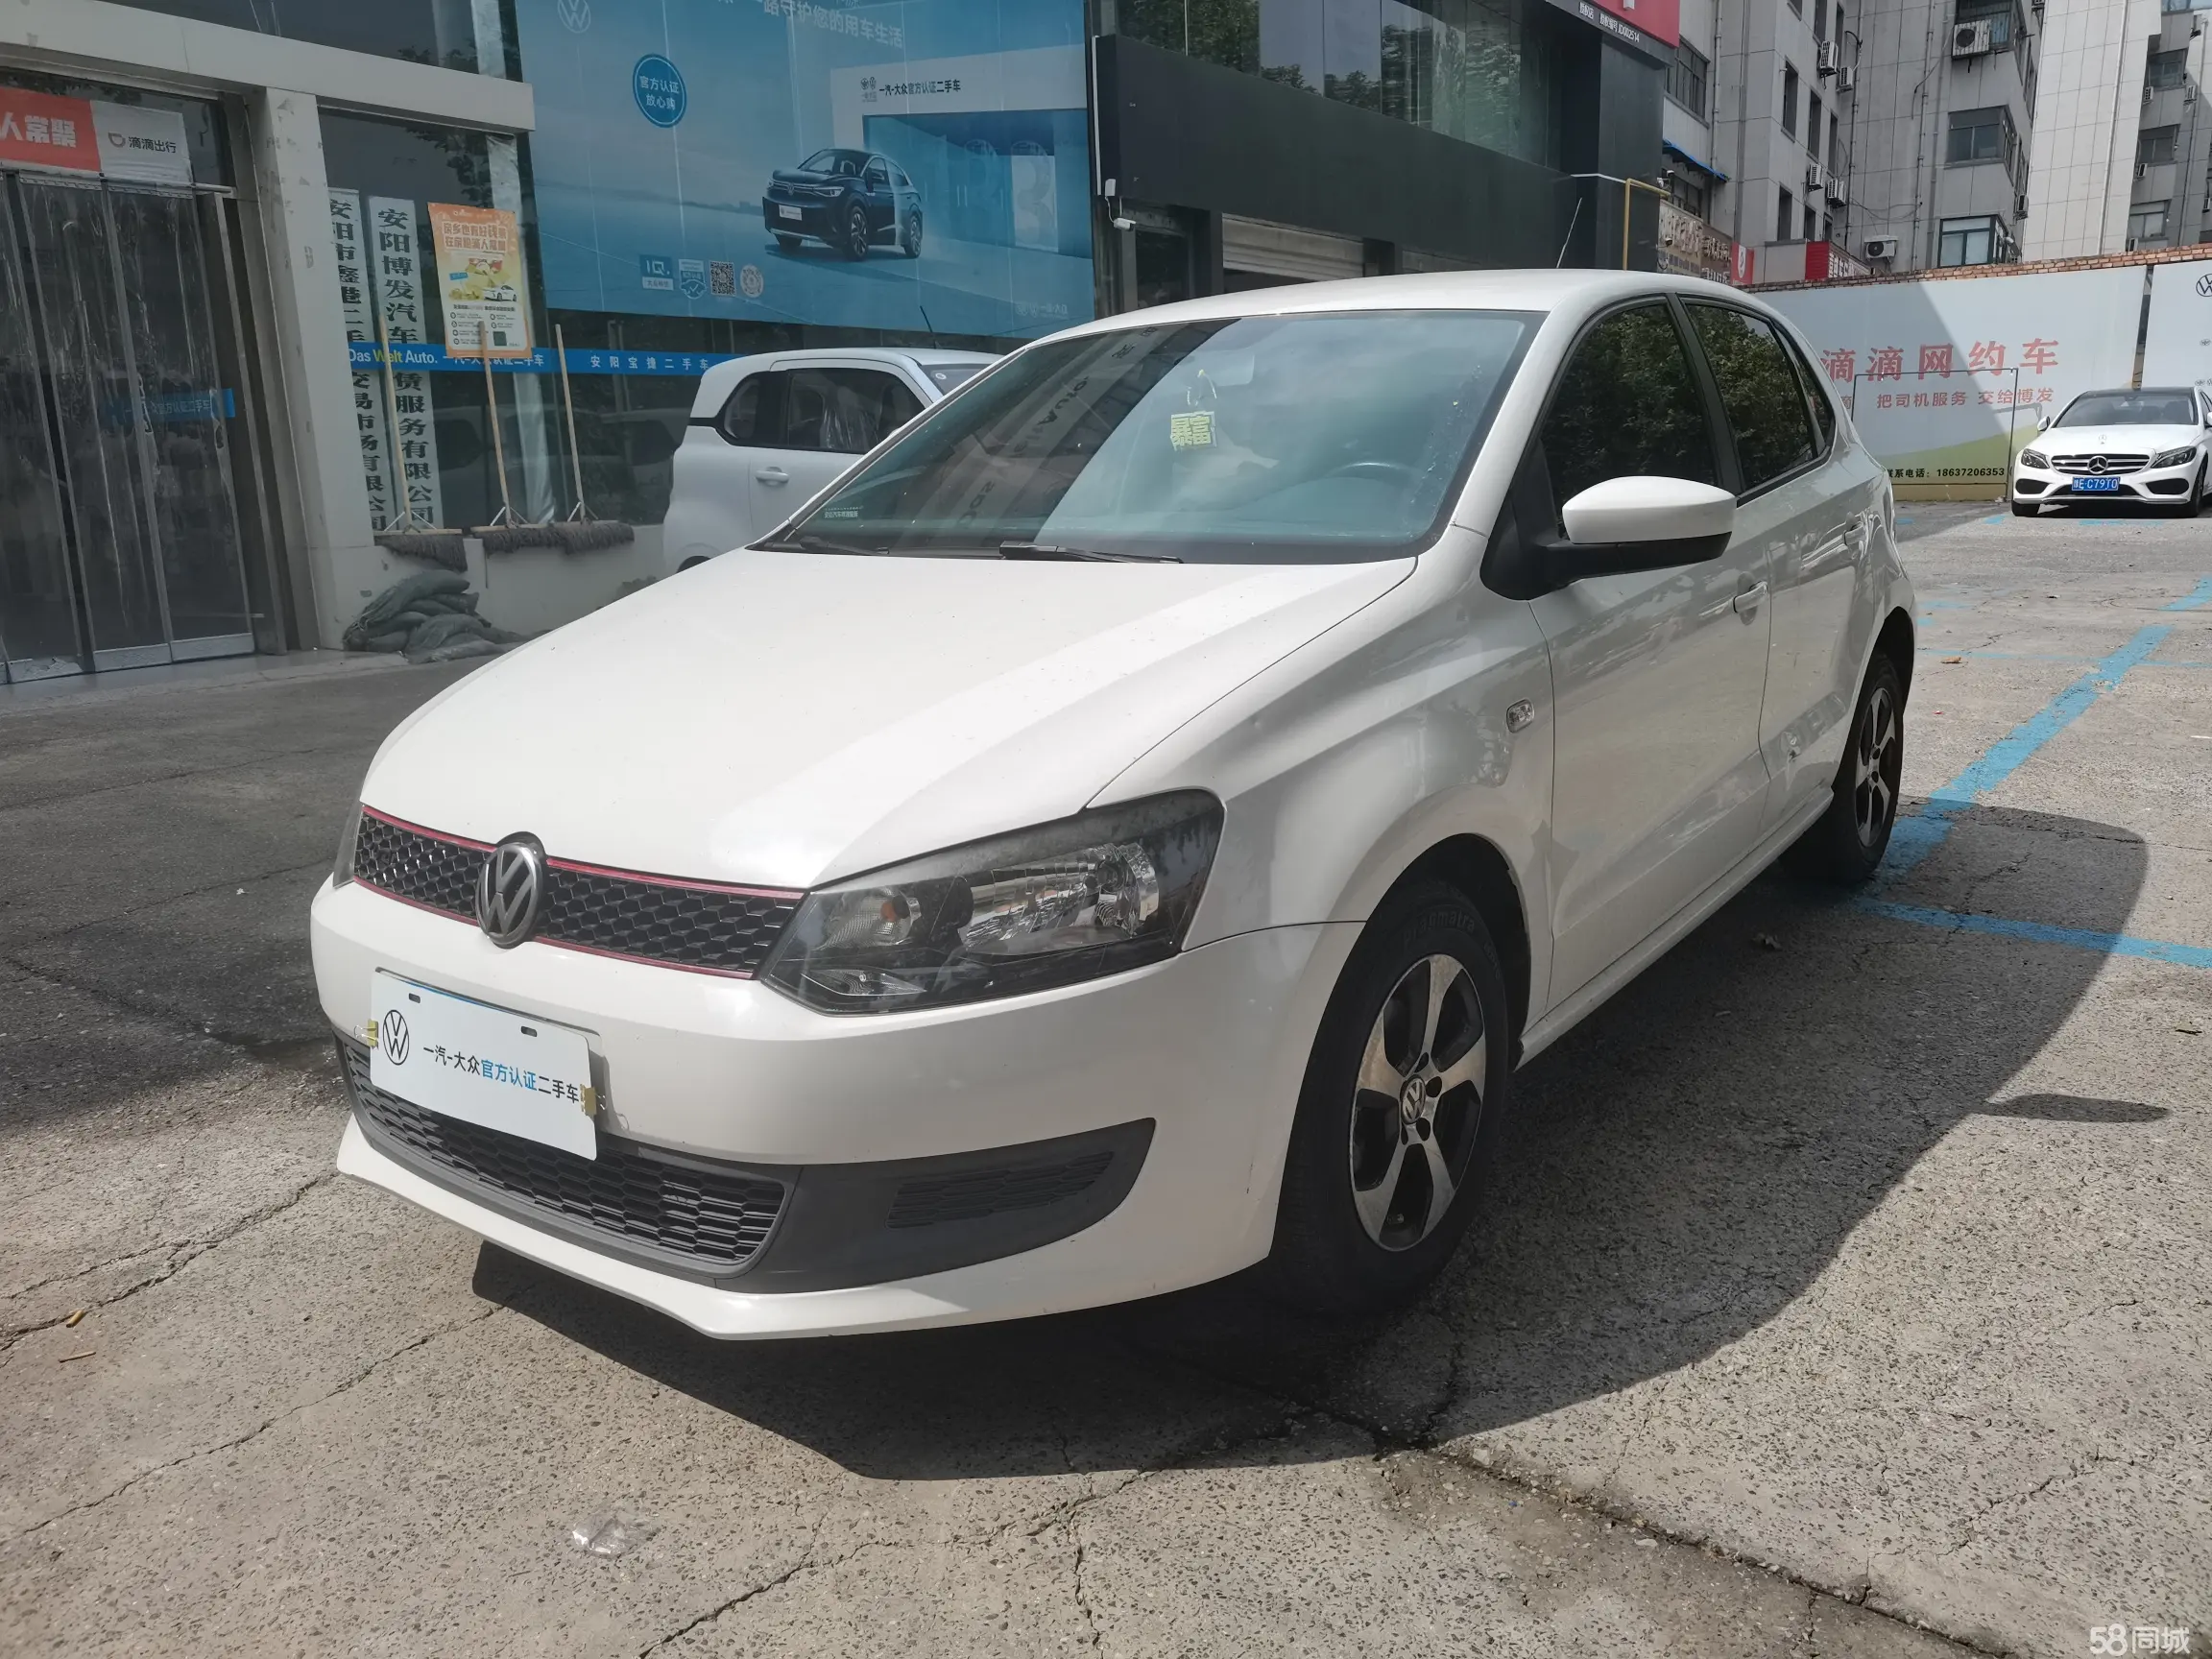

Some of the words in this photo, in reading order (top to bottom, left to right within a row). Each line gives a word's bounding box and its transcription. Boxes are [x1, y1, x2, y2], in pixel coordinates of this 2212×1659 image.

[639, 75, 680, 94] 官方认证
[645, 93, 677, 110] 放心购
[128, 136, 177, 154] 滴滴出行
[349, 350, 372, 363] Das
[404, 350, 439, 365] Auto.
[1820, 337, 2059, 384] 滴滴网约车
[1876, 391, 1968, 410] 把司机服务
[1977, 387, 2055, 406] 交给博发
[1936, 467, 2006, 477] 18637206353
[422, 1044, 579, 1105] 一汽-大众官方认证二手车
